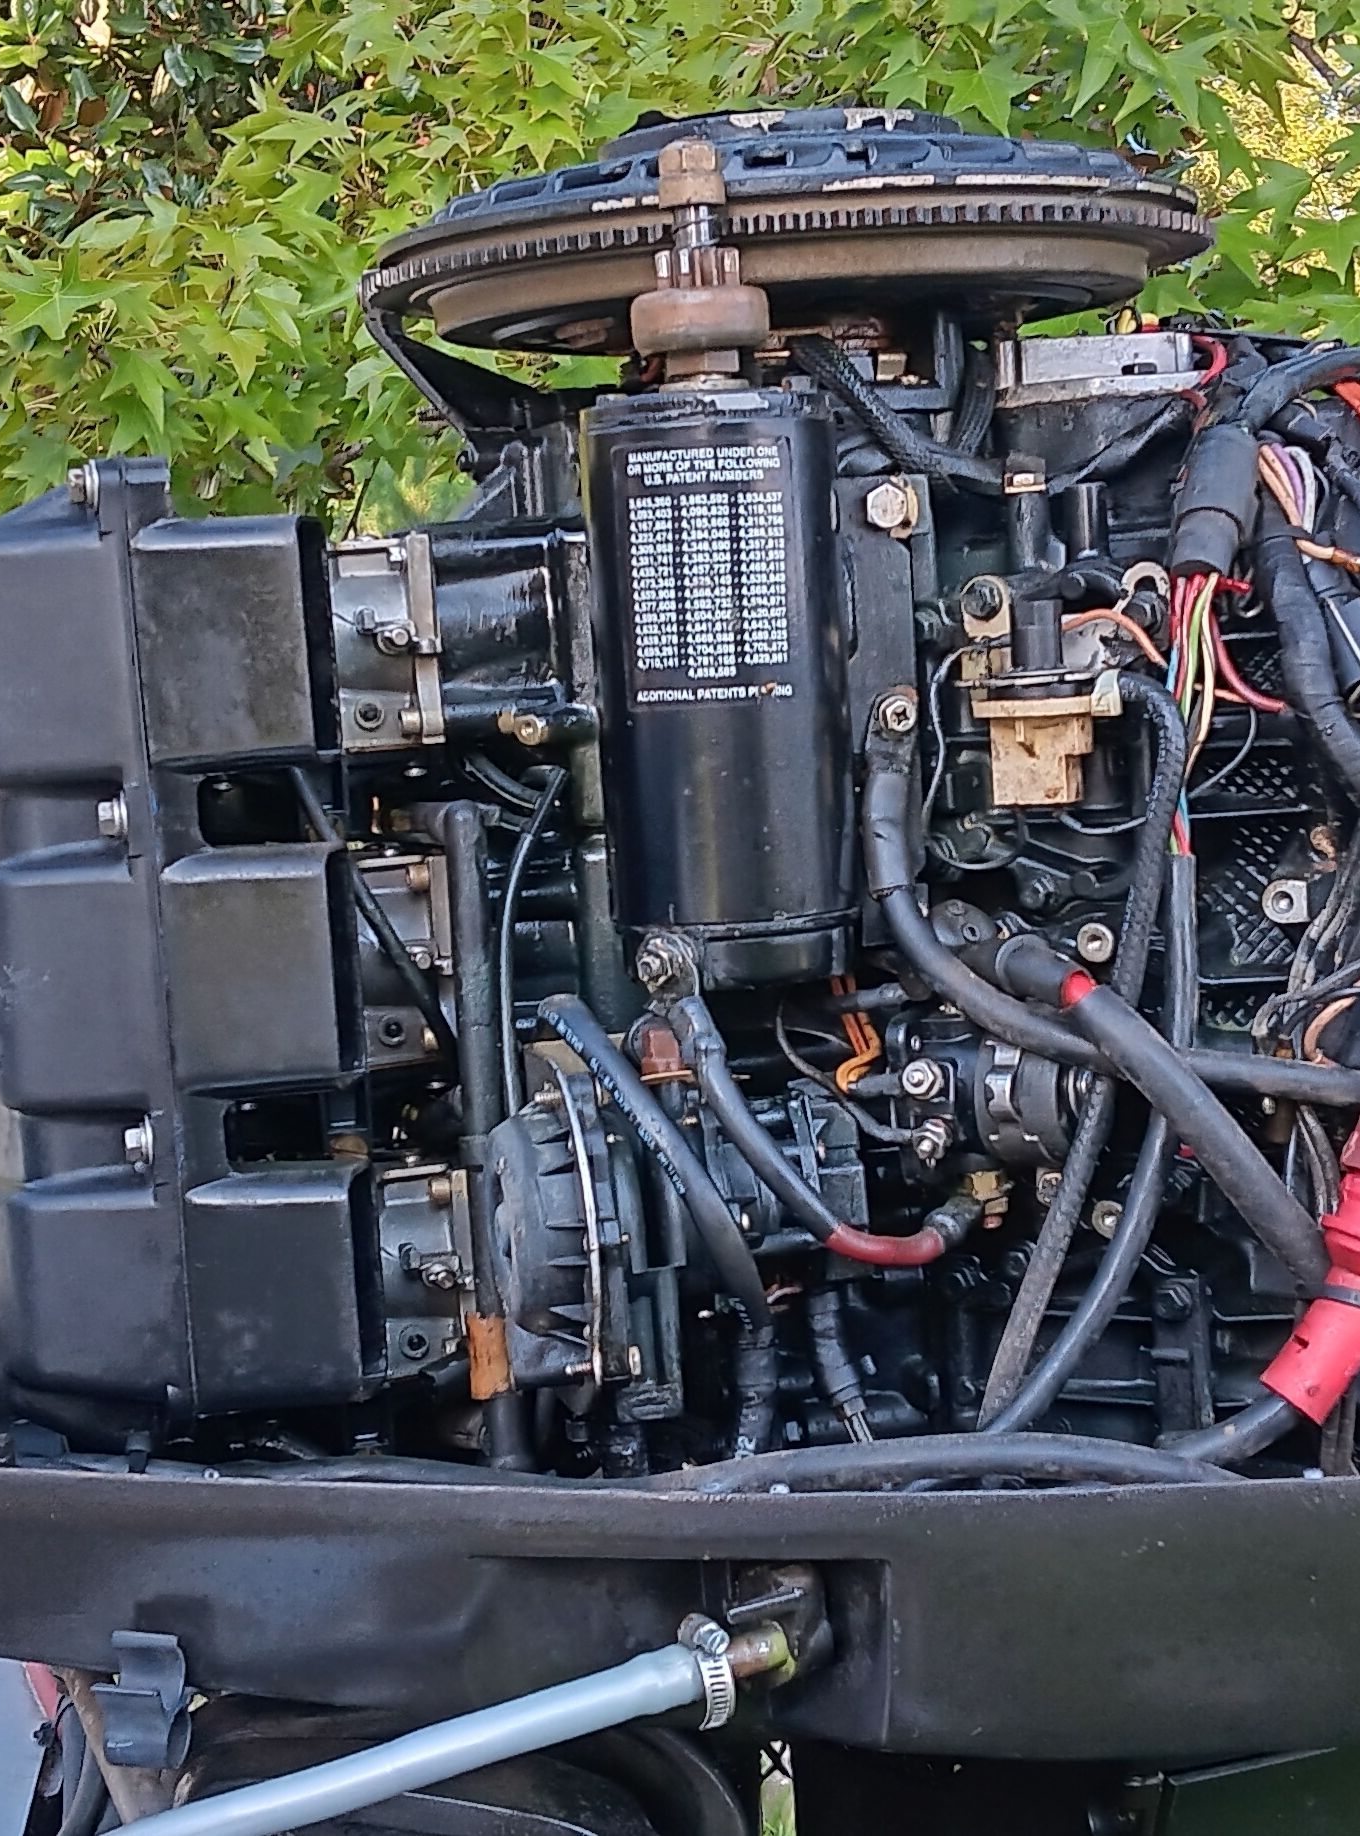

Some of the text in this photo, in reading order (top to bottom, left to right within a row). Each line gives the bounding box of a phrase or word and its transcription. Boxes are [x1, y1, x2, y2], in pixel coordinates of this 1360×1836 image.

[628, 445, 778, 462] MANUFACTURED UNDER ONE
[627, 457, 781, 474] OR MORE OF THE FOLLOWING
[644, 469, 764, 485] U.S. PATENT NUMBERS
[637, 684, 793, 701] ADDITIONAL PATENTS PDING
